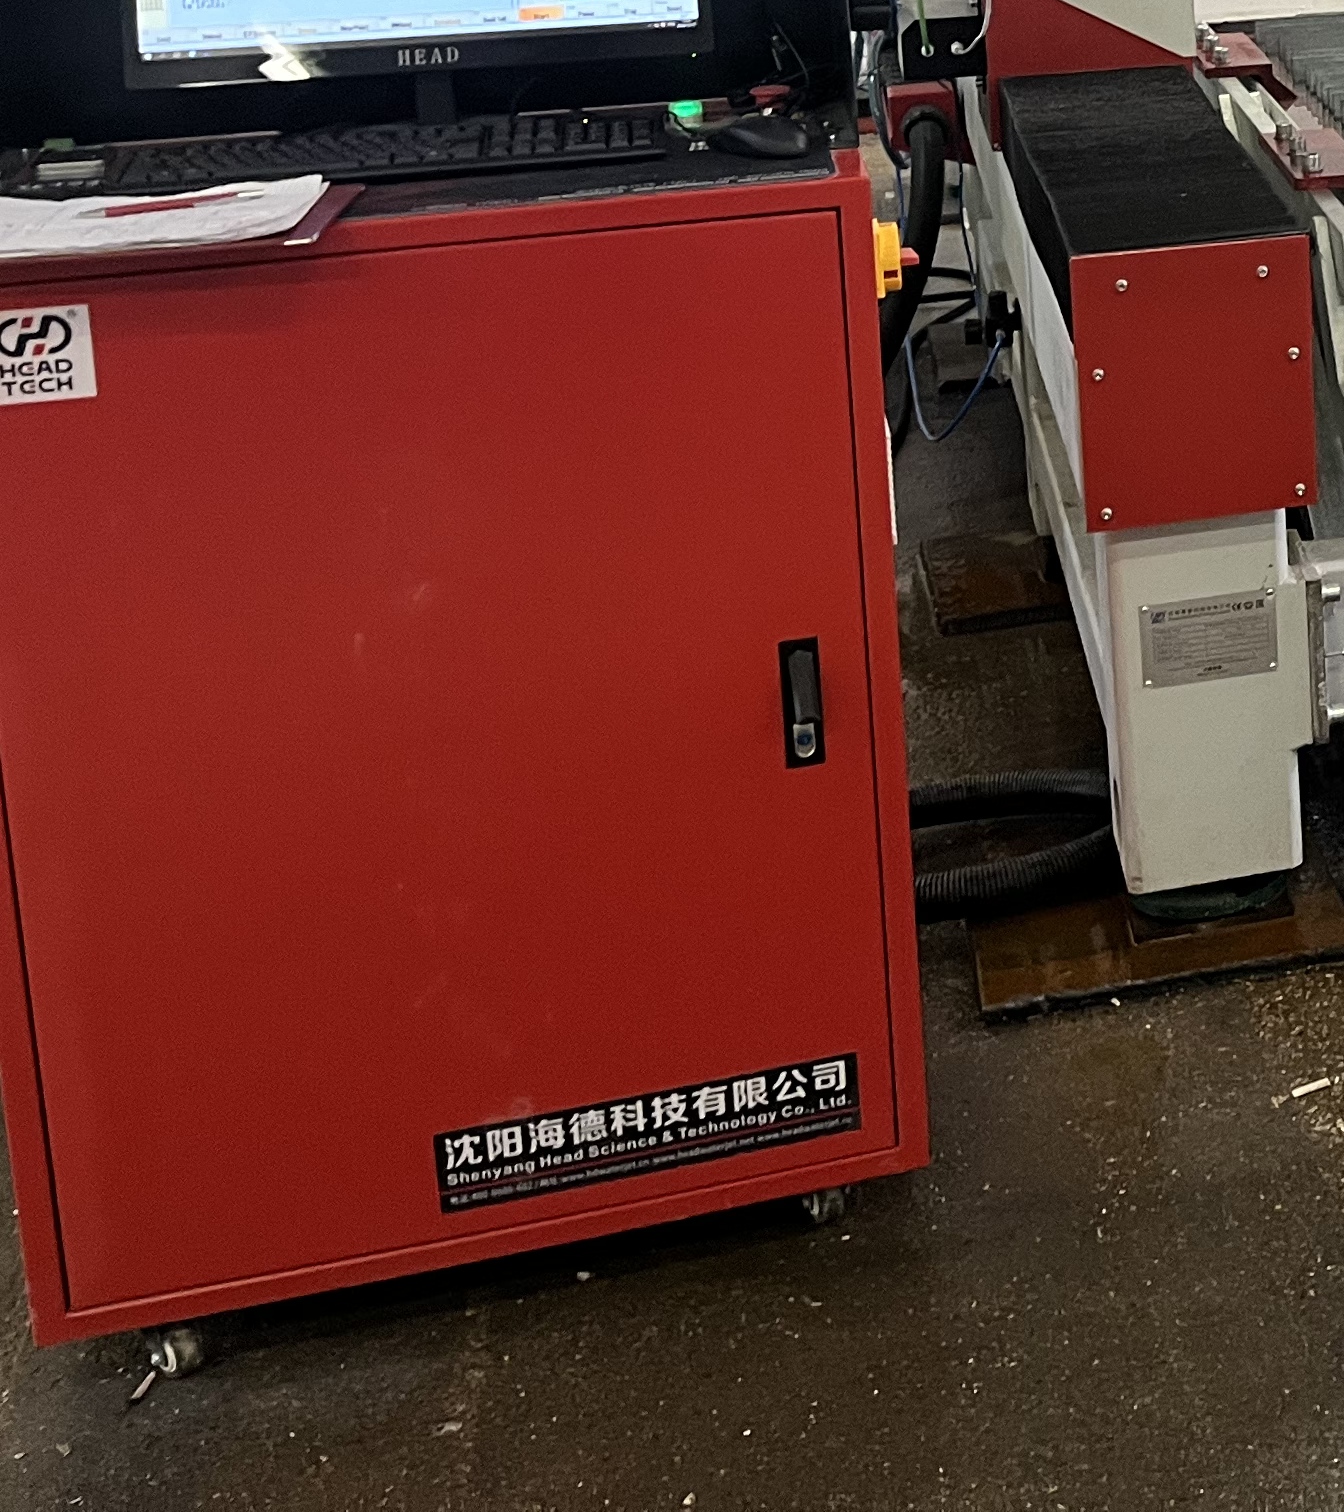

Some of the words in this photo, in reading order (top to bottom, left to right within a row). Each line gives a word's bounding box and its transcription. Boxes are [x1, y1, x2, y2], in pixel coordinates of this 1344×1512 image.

[397, 46, 460, 67] HEAD
[0, 359, 73, 378] HEAD
[2, 375, 73, 395] TECH
[445, 1059, 848, 1171] 沈阳海德科技有限公司
[447, 1160, 536, 1186] Shenyang
[539, 1149, 584, 1169] Head
[588, 1136, 657, 1159] Science
[662, 1130, 674, 1143] &
[678, 1110, 777, 1140] Technology
[819, 1093, 852, 1111] Ltd.
